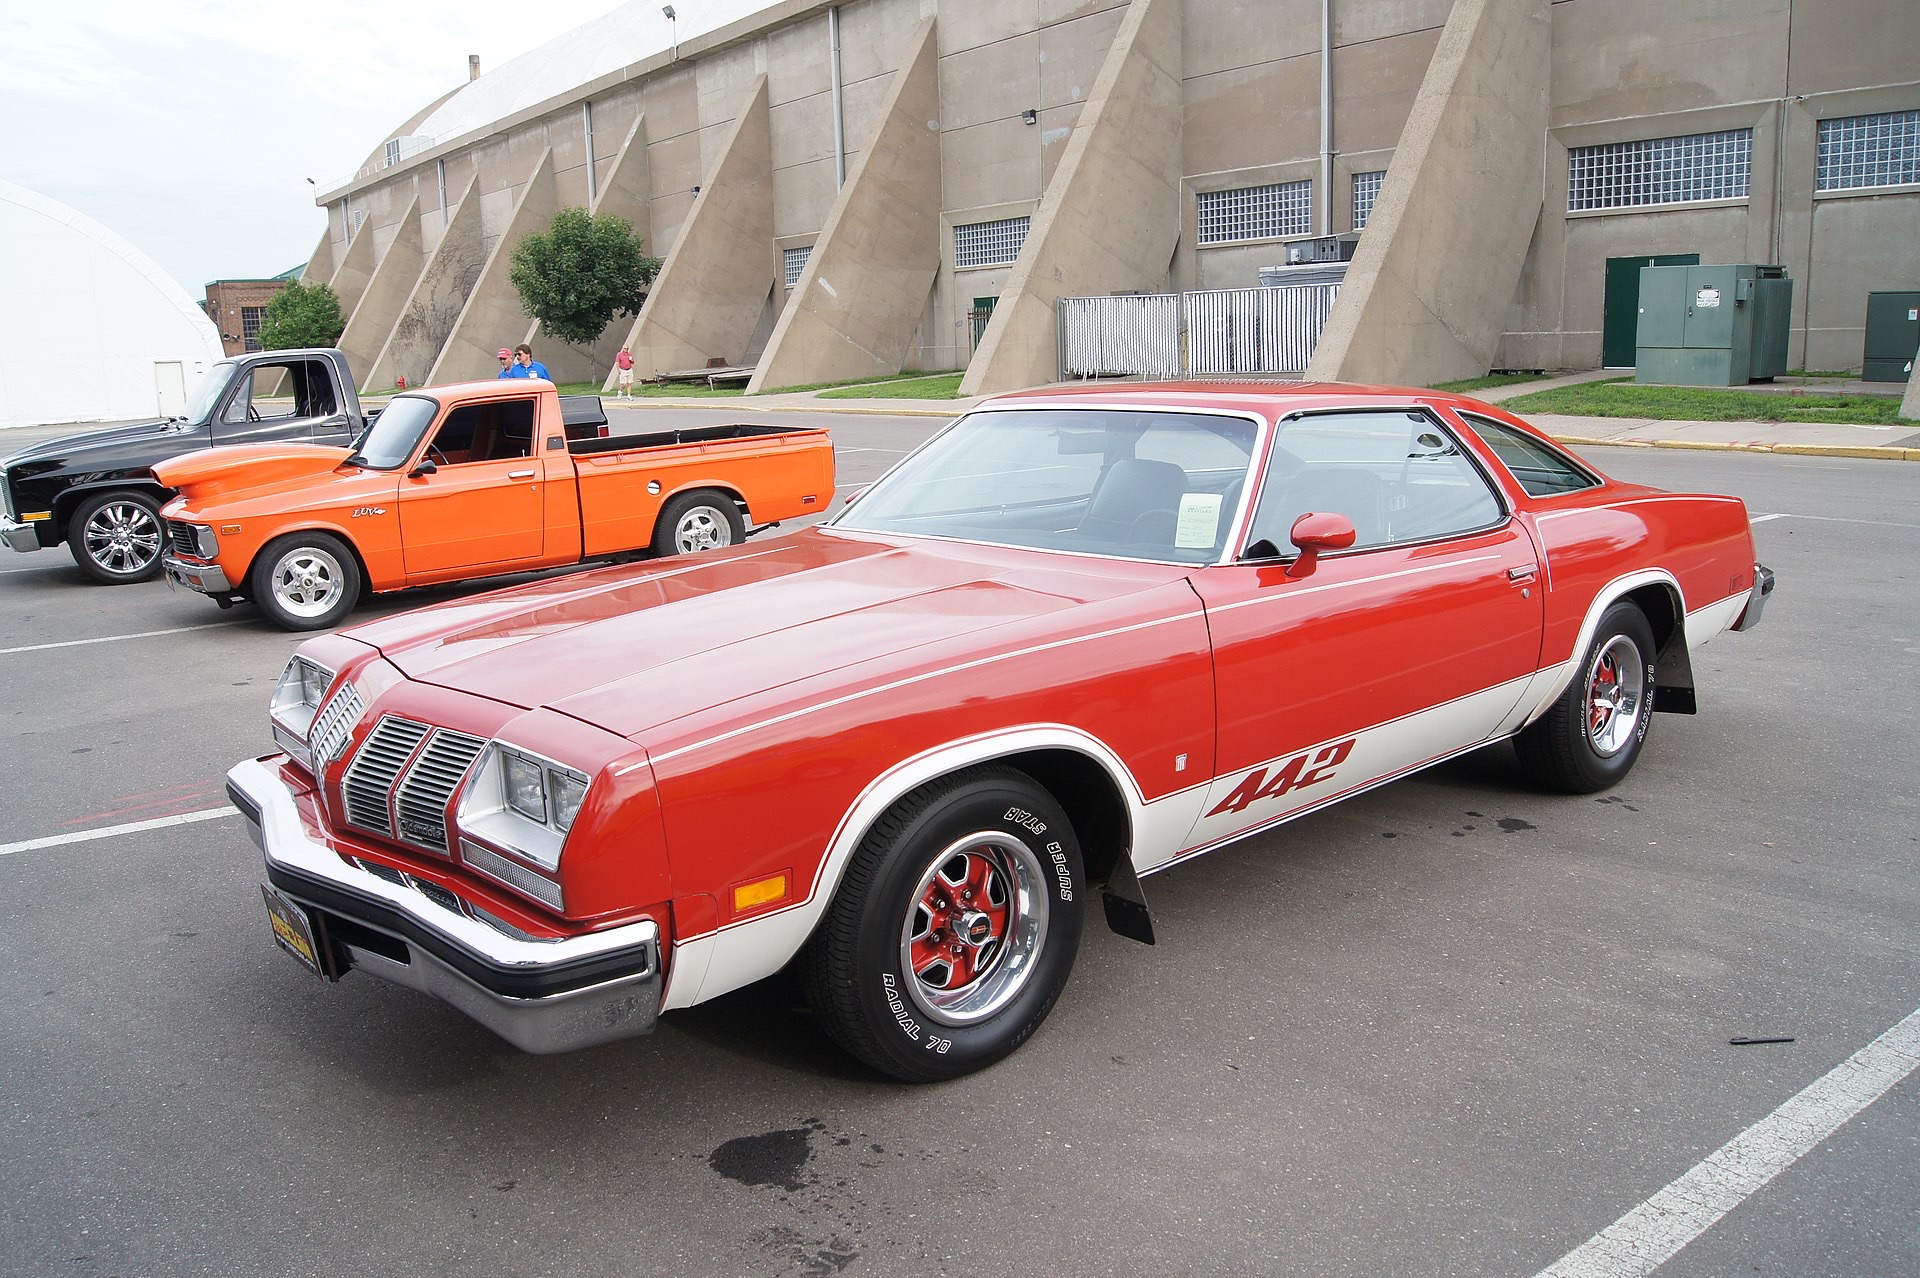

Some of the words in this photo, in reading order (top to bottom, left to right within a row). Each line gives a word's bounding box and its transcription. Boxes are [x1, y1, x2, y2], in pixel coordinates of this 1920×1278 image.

[352, 507, 378, 518] LUV
[1204, 738, 1357, 818] 442
[1003, 807, 1048, 835] STAR
[1046, 841, 1073, 902] SUPER
[882, 973, 921, 1041] RADIAL
[925, 1035, 952, 1054] 70
